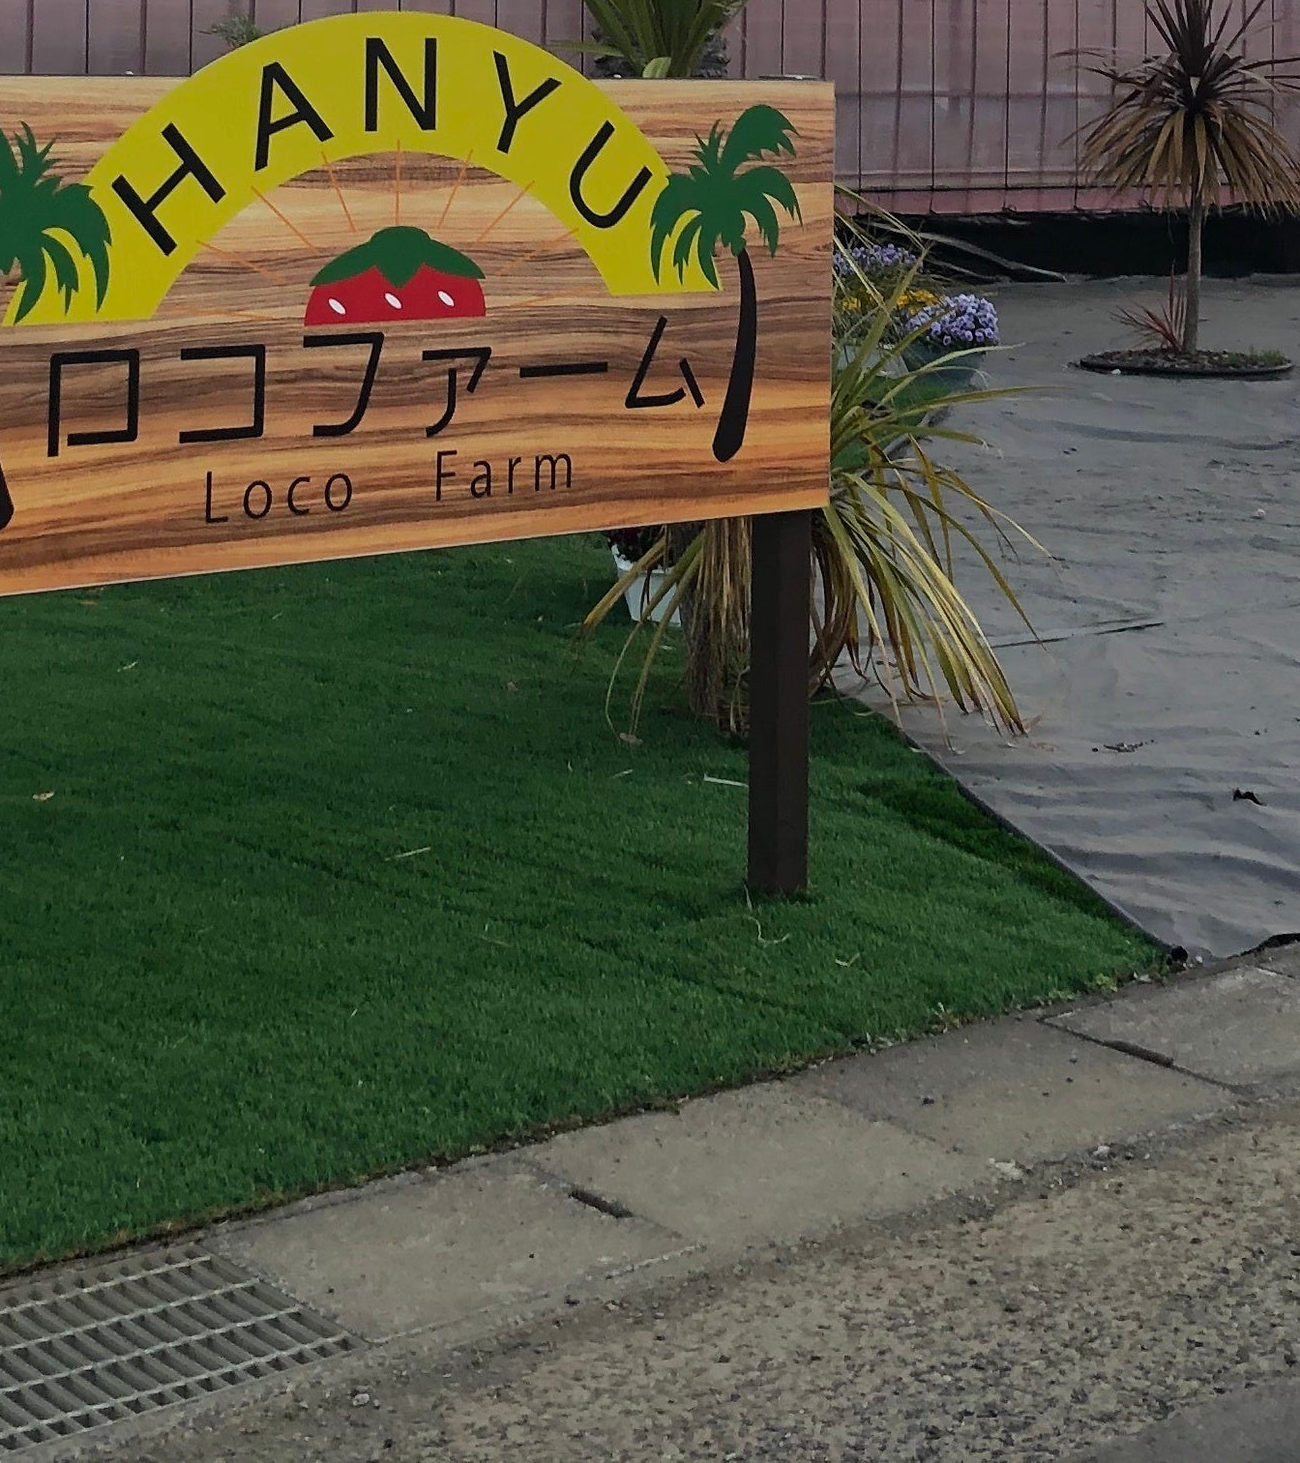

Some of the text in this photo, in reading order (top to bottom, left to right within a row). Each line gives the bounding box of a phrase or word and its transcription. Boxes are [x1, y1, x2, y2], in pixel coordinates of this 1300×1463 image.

[111, 36, 653, 257] HANYU
[47, 316, 705, 458] ロコファーム
[205, 449, 572, 523] Loco Farm
